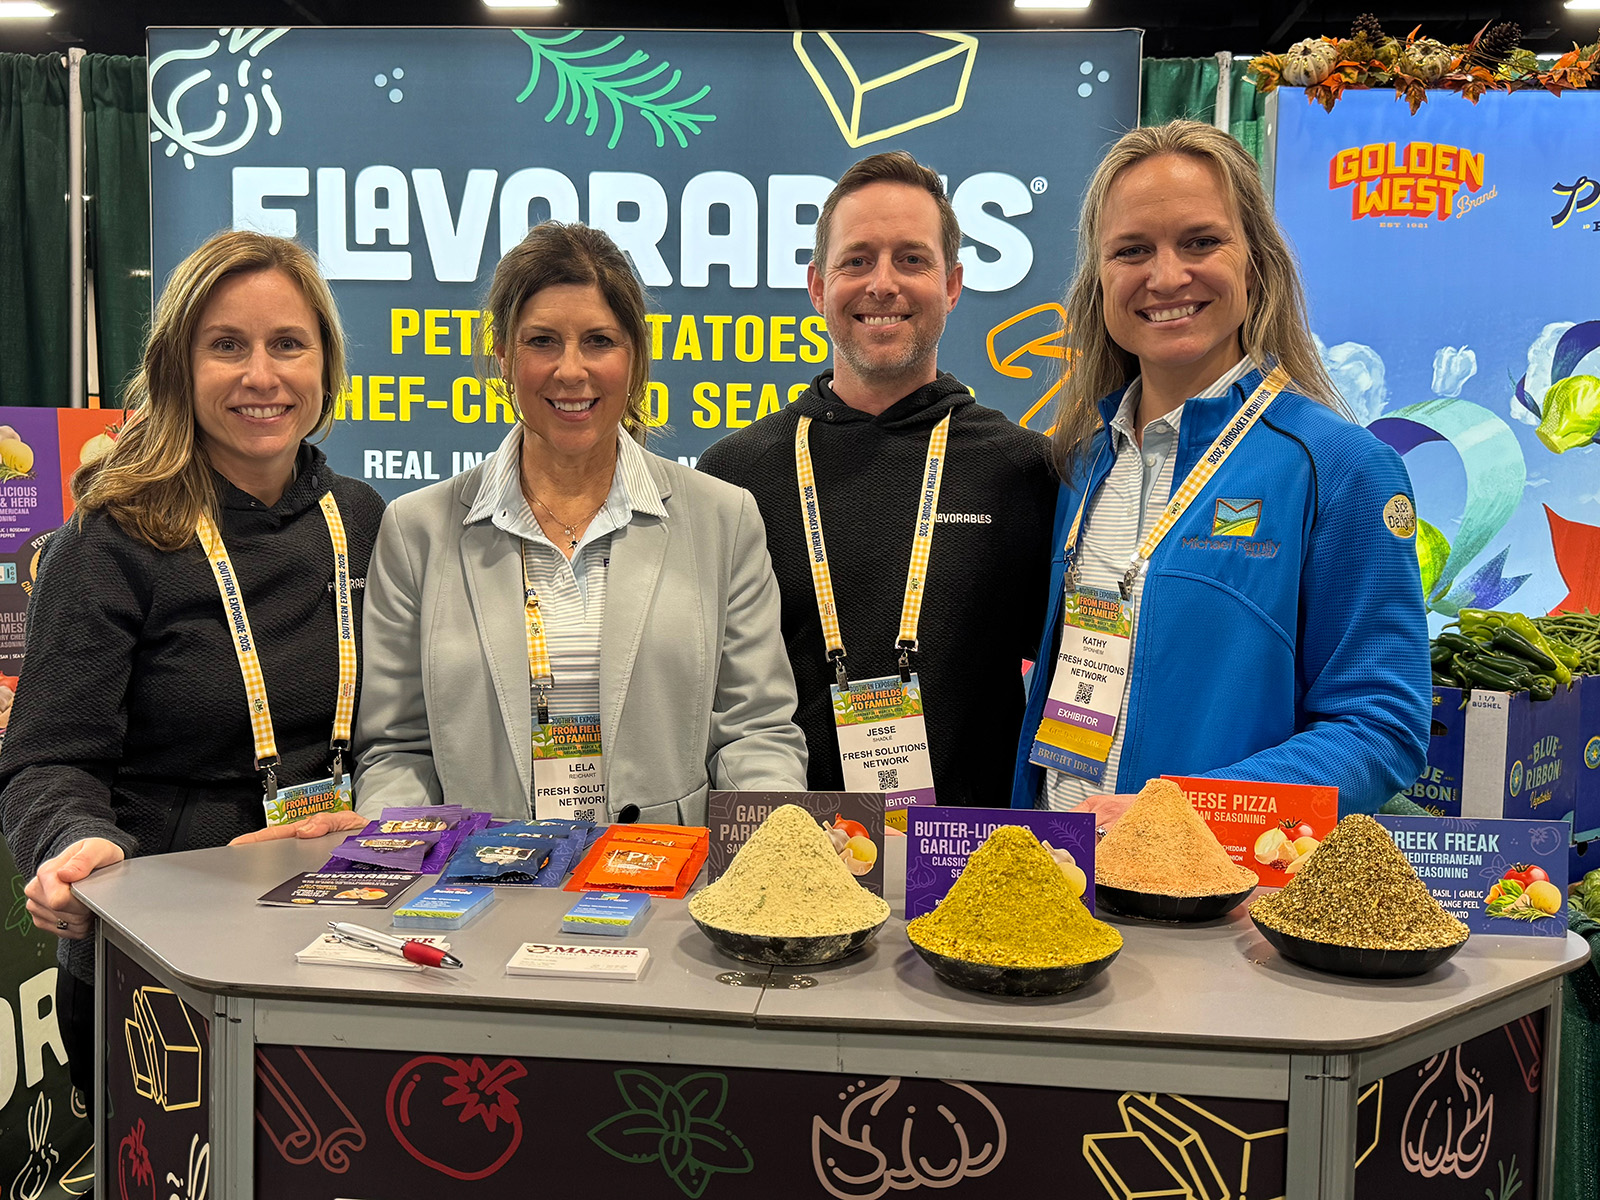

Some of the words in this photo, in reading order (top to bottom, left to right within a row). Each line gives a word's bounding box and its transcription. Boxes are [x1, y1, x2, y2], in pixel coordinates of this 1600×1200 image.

[1329, 141, 1485, 193] GOLDEN
[1352, 177, 1460, 221] WEST
[1456, 184, 1498, 219] Brand
[645, 314, 829, 364] TATOES
[1244, 389, 1271, 419] SOUTHERN
[1219, 416, 1249, 449] EXPOSURE
[363, 449, 441, 480] REAL
[1207, 447, 1225, 465] 2026
[926, 457, 940, 489] SOUTHERN
[0, 486, 38, 497] LICIOUS
[803, 485, 814, 500] 2026
[11, 497, 38, 508] HERB
[921, 490, 934, 521] EXPOSURE
[806, 500, 819, 530] EXPOSURE
[935, 512, 992, 524] LAVORABLES
[918, 522, 929, 537] 2026
[811, 530, 824, 563] SOUTHERN
[1182, 538, 1233, 551] Michael
[1235, 539, 1281, 558] Family
[339, 571, 348, 604] EXPOSURE
[216, 560, 236, 597] SOUTHERN
[228, 597, 246, 634] EXPOSURE
[238, 634, 252, 652] 2026
[1080, 596, 1098, 608] FROM
[1099, 600, 1119, 612] FIELDS
[1080, 605, 1088, 615] TO
[1088, 607, 1118, 621] FAMILIES
[340, 605, 351, 640] SOUTHERN
[1082, 636, 1107, 648] KATHY
[1058, 652, 1082, 666] FRESH
[1083, 658, 1125, 676] SOLUTIONS
[1071, 667, 1107, 683] NETWORK
[851, 692, 875, 702] FROM
[875, 688, 901, 699] FIELDS
[853, 702, 864, 711] TO
[864, 696, 903, 710] FAMILIES
[1472, 702, 1502, 710] BUSHEL
[1057, 708, 1098, 727] EXHIBITOR
[552, 725, 578, 735] FROM
[580, 724, 600, 734] FIELD
[866, 726, 896, 737] JESSE
[554, 735, 566, 744] TO
[566, 733, 602, 744] FAMILIE
[842, 749, 873, 761] FRESH
[874, 742, 927, 757] SOLUTIONS
[1533, 735, 1559, 765] BLUE
[569, 762, 595, 772] LELA
[863, 755, 909, 769] NETWORK
[1038, 747, 1073, 767] BRIGHT
[1074, 760, 1099, 776] IDEAS
[1421, 765, 1444, 784] UE
[1525, 759, 1560, 791] RIBBON
[537, 786, 570, 797] FRESH
[573, 783, 606, 794] SOLUT
[286, 797, 309, 810] FROM
[309, 791, 334, 805] FIELDS
[885, 795, 917, 808] IBITOR
[1232, 794, 1278, 813] PIZZA
[286, 808, 298, 819] TO
[298, 800, 335, 816] FAMILIES
[1214, 811, 1266, 825] SEASONING
[885, 815, 908, 824] SPON
[920, 838, 971, 855] GARLIC
[1445, 832, 1500, 852] FREAK
[932, 856, 966, 866] CLASSIC
[1413, 866, 1468, 878] SEASONING
[1432, 889, 1451, 898] BASIL
[1459, 890, 1484, 899] GARLIC
[1439, 900, 1461, 908] RANGE
[1463, 901, 1480, 909] PEEL
[553, 946, 639, 956] MASSER
